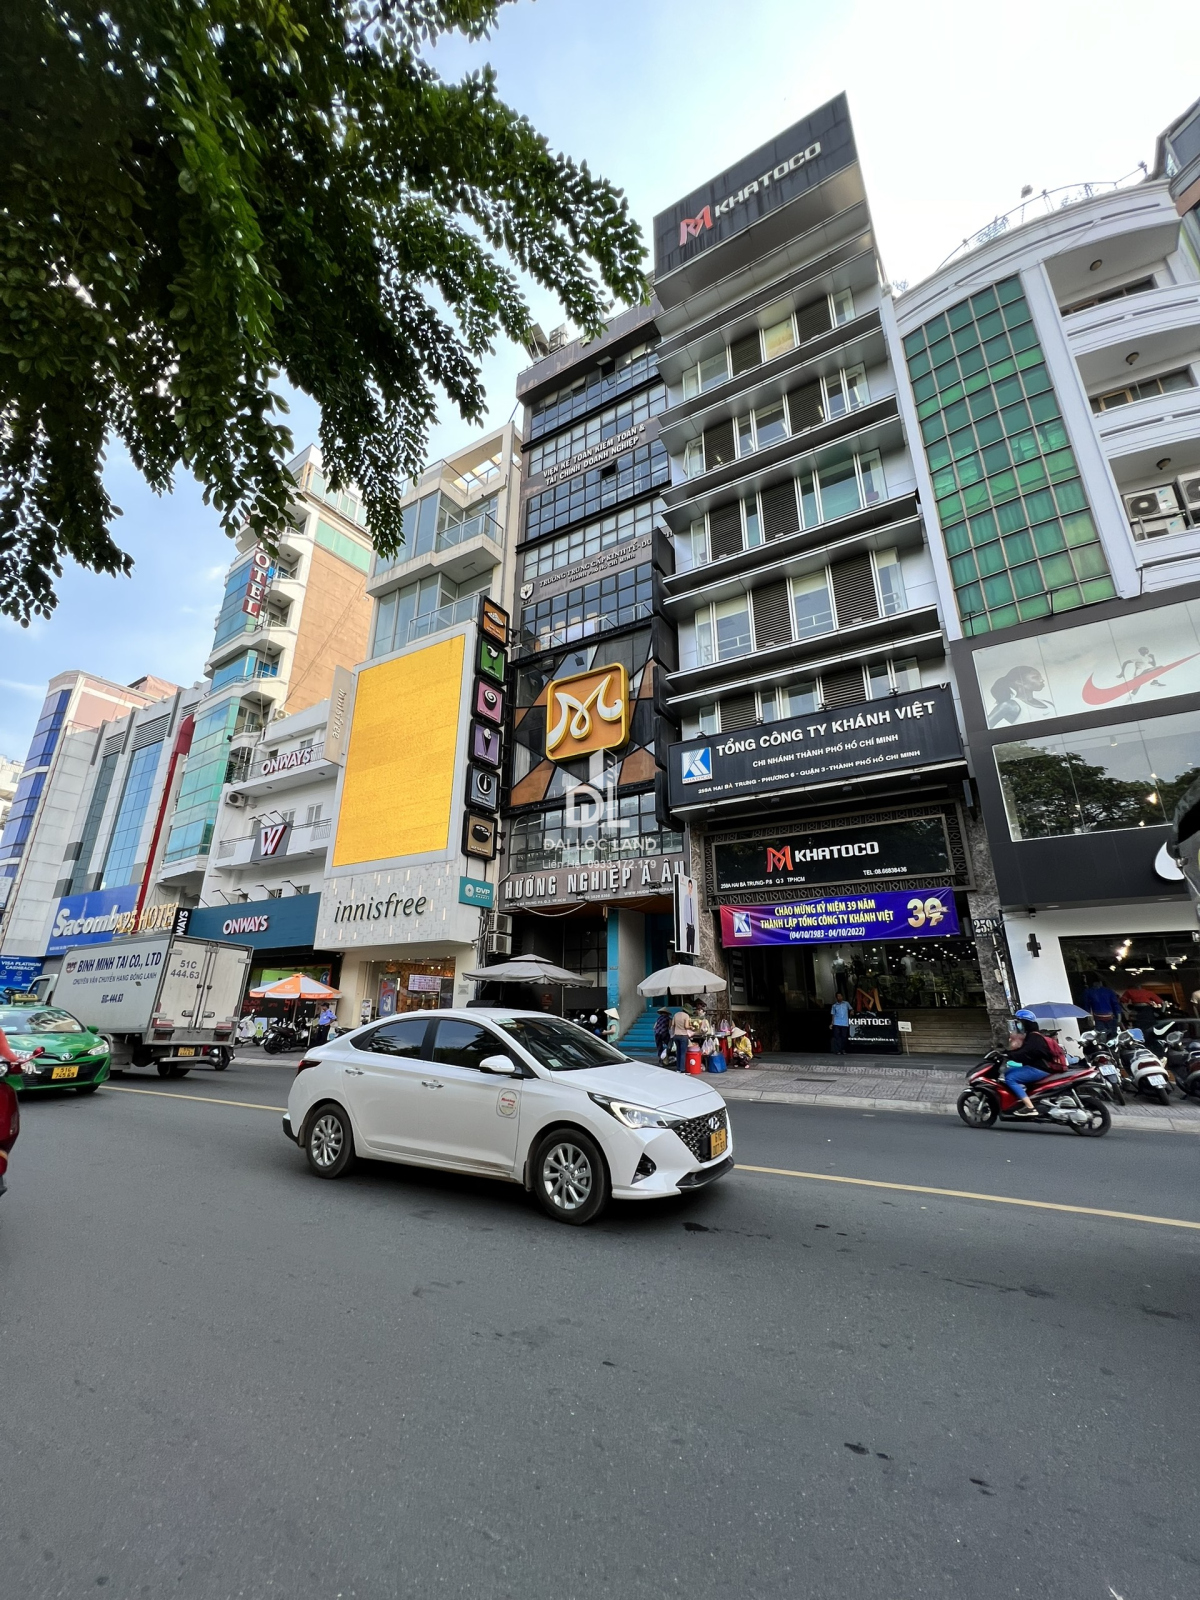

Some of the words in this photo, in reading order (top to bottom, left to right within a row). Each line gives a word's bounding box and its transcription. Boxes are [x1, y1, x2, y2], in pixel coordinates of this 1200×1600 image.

[714, 141, 822, 218] KHATOCO
[638, 423, 646, 433] &
[583, 451, 610, 469] DOANH
[331, 688, 348, 740] innisfree
[716, 738, 757, 757] TỔNG
[759, 729, 804, 748] CÔNG
[806, 723, 828, 738] TY
[831, 711, 891, 733] KHÁNH
[894, 700, 936, 719] VIỆT
[260, 747, 314, 776] ONWAYS
[752, 760, 767, 768] CHI
[767, 754, 795, 766] NHÁNH
[795, 748, 824, 759] THÀNH
[825, 742, 844, 754] PHỐ
[859, 736, 876, 748] CHÍ
[876, 734, 900, 745] MINH
[855, 756, 872, 767] PHỐ
[900, 750, 921, 759] MINH
[794, 841, 880, 863] KHATOCO
[504, 872, 557, 900] HƯỚNG
[567, 864, 632, 894] NGHIỆP
[333, 892, 427, 924] innisfree
[774, 904, 793, 917] CHÀO
[793, 901, 816, 915] MỪNG
[827, 898, 847, 914] NIỆM
[846, 899, 857, 911] 39
[857, 898, 876, 910] NĂM
[222, 914, 270, 936] ONWAYS
[760, 916, 784, 930] THÀNH
[783, 914, 798, 930] LẬP
[818, 912, 838, 926] CÔNG
[838, 914, 849, 924] TY
[848, 910, 877, 923] KHÁNH
[876, 908, 894, 924] VIỆT
[828, 926, 866, 938] 04/10/2022)
[77, 959, 95, 973] BINH
[95, 957, 114, 971] MINH
[145, 951, 162, 967] LTD
[179, 959, 198, 970] 51C
[170, 969, 200, 980] 444.63
[848, 1018, 892, 1026] KHATOCO
